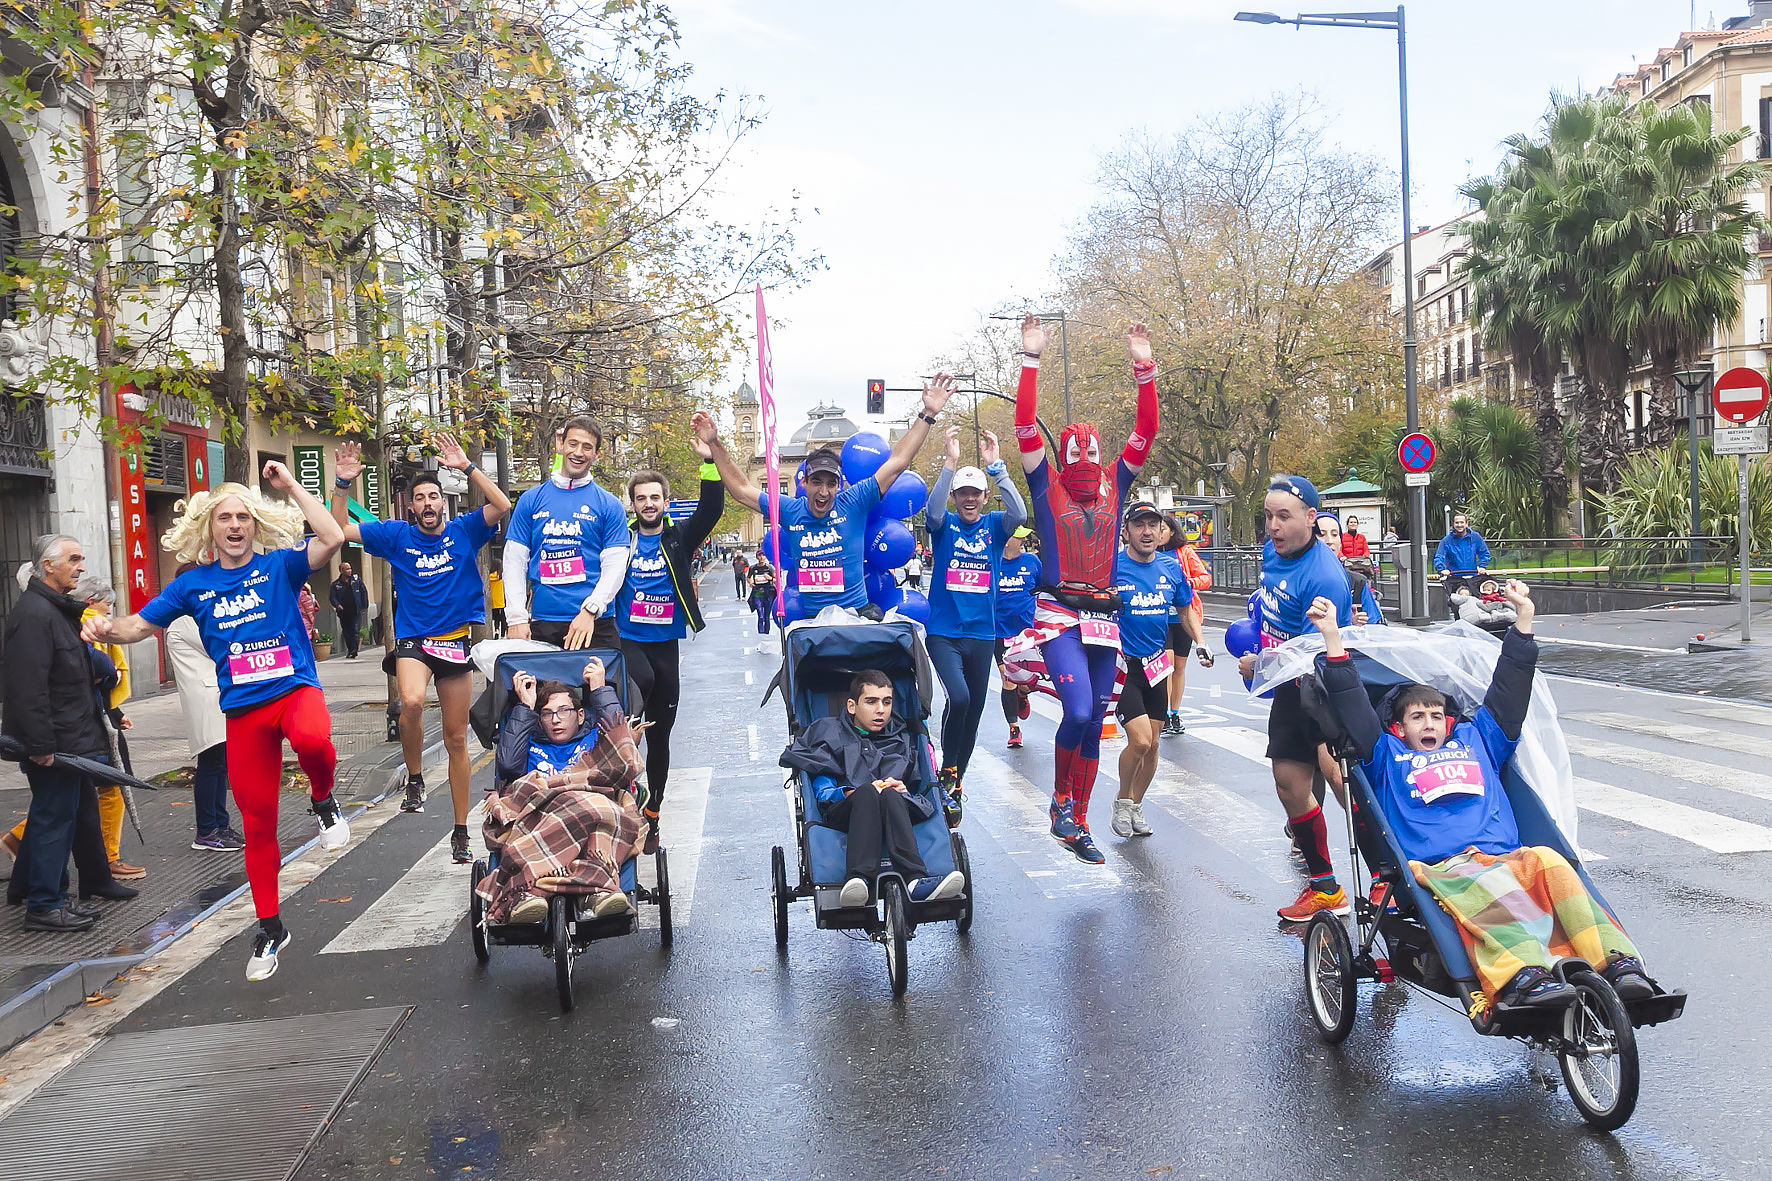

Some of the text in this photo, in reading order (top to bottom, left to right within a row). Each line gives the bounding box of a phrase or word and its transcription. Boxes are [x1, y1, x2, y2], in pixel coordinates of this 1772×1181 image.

[572, 512, 595, 522] ZURICH
[130, 484, 145, 588] SPAR
[547, 550, 575, 559] ZURICH
[802, 546, 843, 557] #Imparables
[548, 562, 572, 574] 118
[960, 561, 986, 570] ZURICH
[242, 575, 268, 588] ZURICH
[810, 571, 831, 582] 119
[959, 572, 979, 583] 122
[644, 604, 664, 615] 109
[218, 611, 266, 629] #Imparables
[1093, 622, 1112, 636] 112
[1269, 628, 1289, 640] ZURICH
[245, 638, 280, 652] ZURICH
[434, 649, 452, 658] 111
[246, 652, 276, 669] 108
[1150, 660, 1164, 674] 114
[1428, 750, 1468, 762] ZURICH
[1434, 764, 1468, 781] 104
